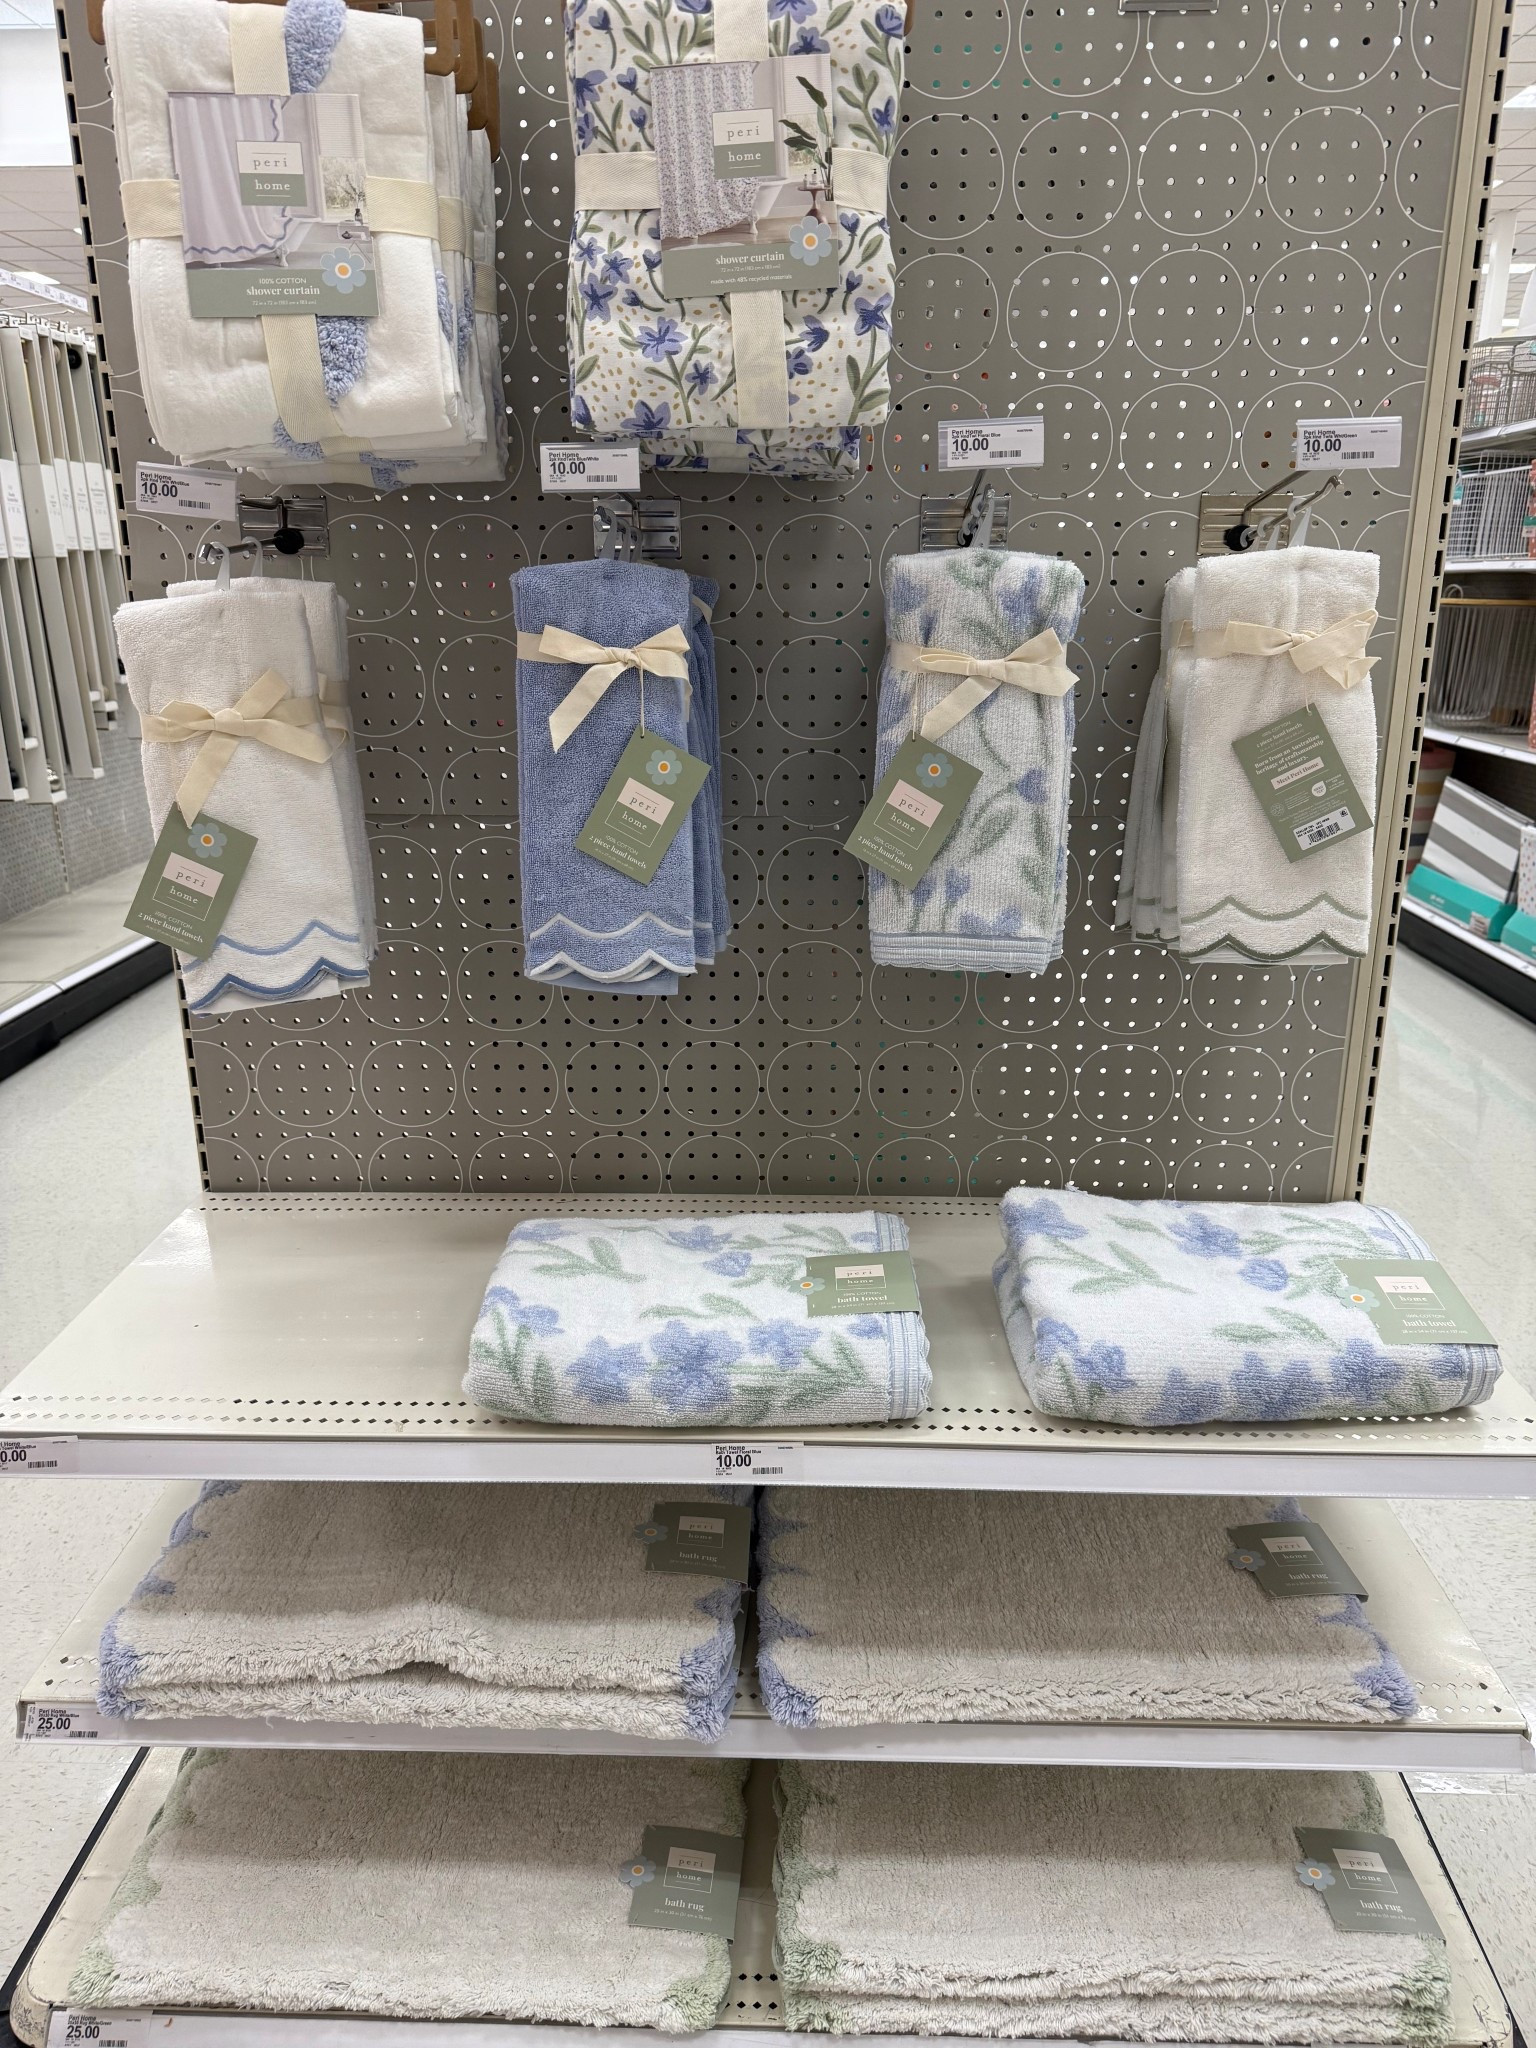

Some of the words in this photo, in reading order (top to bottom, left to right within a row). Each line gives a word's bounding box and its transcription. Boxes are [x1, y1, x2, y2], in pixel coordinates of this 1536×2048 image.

[727, 125, 760, 141] peri
[728, 150, 761, 162] home
[253, 157, 288, 170] peri
[255, 180, 291, 191] home
[716, 255, 748, 265] shower
[750, 252, 784, 262] curtain
[247, 286, 281, 296] shower
[284, 286, 320, 295] curtain
[953, 438, 989, 451] 10.00
[1304, 439, 1341, 452] 10.00
[550, 462, 585, 474] 10.00
[142, 482, 178, 497] 10.00
[1254, 759, 1268, 769] Born
[1268, 752, 1282, 763] from
[1292, 735, 1320, 751] Australian
[1256, 761, 1277, 775] heritage
[1278, 757, 1284, 765] of
[1285, 740, 1324, 762] craftsmanship
[1276, 776, 1290, 785] Meet
[1290, 770, 1302, 778] Peri
[1304, 762, 1319, 772] Home
[1278, 763, 1288, 772] and
[629, 796, 657, 814] peri
[898, 798, 925, 817] peri
[622, 811, 647, 831] home
[891, 812, 916, 832] home
[593, 837, 610, 850] piece
[610, 846, 628, 859] hand
[627, 854, 647, 869] towels
[616, 840, 638, 855] COTTON
[862, 837, 878, 852] piece
[878, 846, 895, 861] hand
[894, 854, 913, 872] towels
[884, 842, 906, 858] COTTON
[176, 872, 207, 888] peri
[170, 886, 198, 904] home
[143, 913, 162, 926] piece
[162, 920, 181, 934] hand
[182, 928, 203, 943] towels
[168, 916, 193, 930] COTTON
[0, 1450, 26, 1462] 0.00
[717, 1454, 751, 1467] 10.00
[38, 1718, 70, 1730] 25.00
[678, 1859, 704, 1867] peri
[676, 1872, 701, 1881] home
[1354, 1873, 1381, 1882] home
[665, 1898, 685, 1908] bath
[688, 1903, 704, 1912] rug
[1360, 1900, 1383, 1910] bath
[1384, 1904, 1403, 1912] rug
[66, 2026, 100, 2038] 25.00
